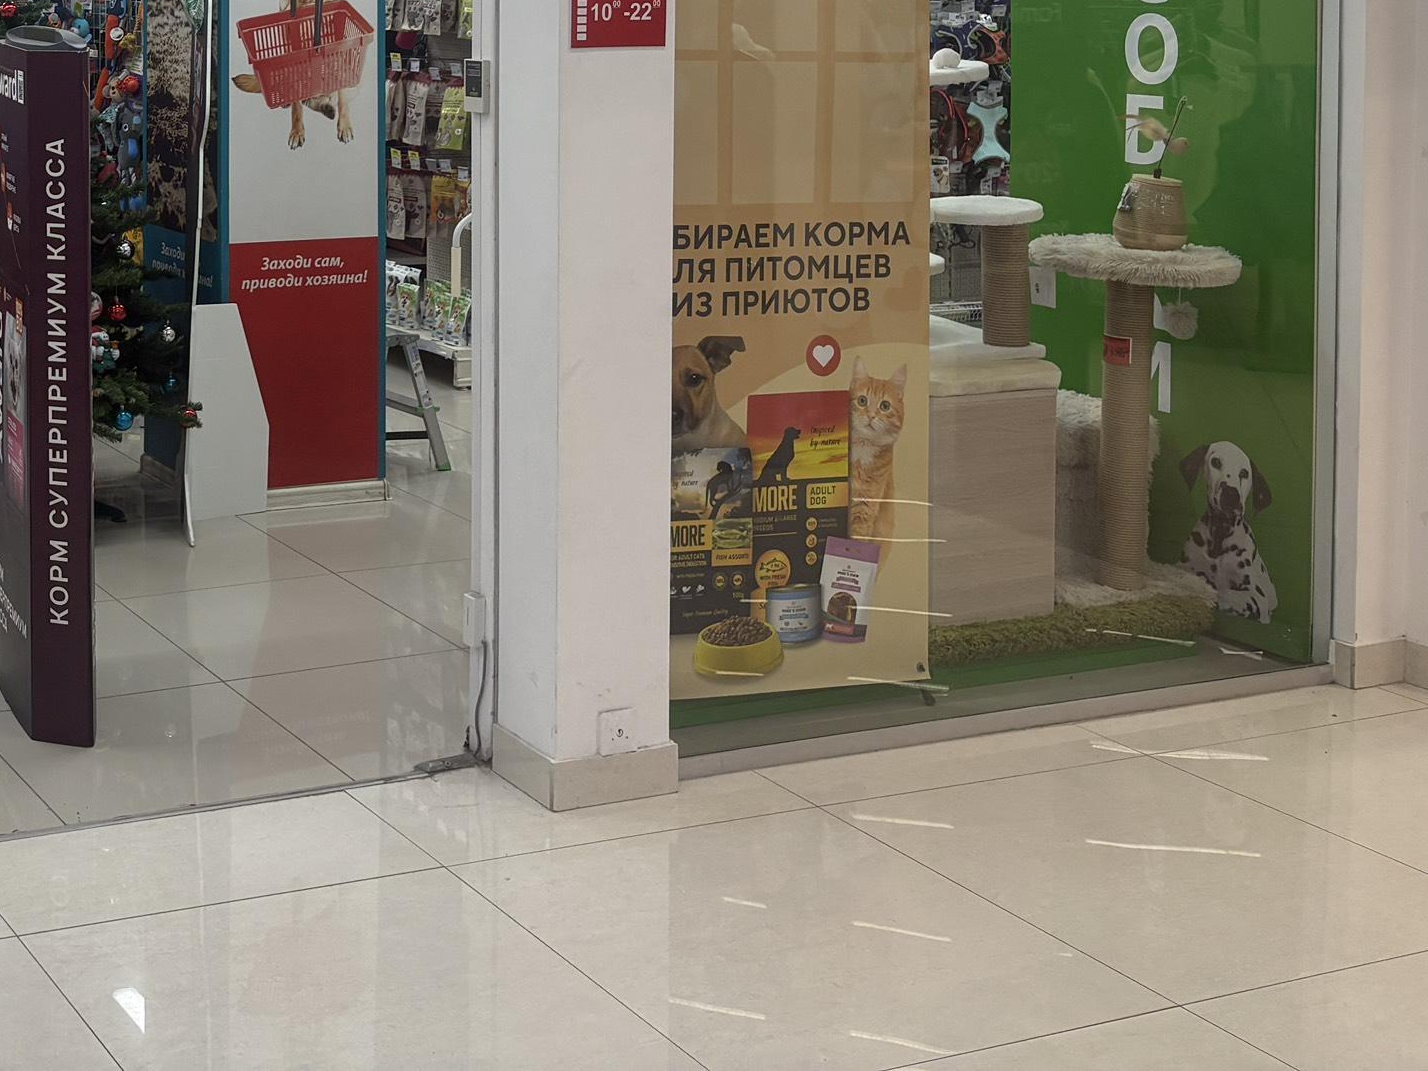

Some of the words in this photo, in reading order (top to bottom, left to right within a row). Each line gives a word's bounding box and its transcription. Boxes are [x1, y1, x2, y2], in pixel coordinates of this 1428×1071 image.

[45, 138, 66, 261] КЛАССА
[673, 223, 794, 250] БИРАЕМ
[804, 221, 911, 247] КОРМА
[161, 242, 186, 261] Заходи
[261, 255, 312, 271] Заходи
[315, 257, 345, 269] сам,
[241, 274, 303, 292] приводи
[305, 270, 369, 287] хозяина!
[673, 258, 716, 283] ЛЯ
[725, 254, 892, 283] ПИТОМЦЕВ
[673, 292, 713, 317] ИЗ
[722, 287, 870, 316] ПРИЮТОВ
[46, 273, 69, 529] СУПЕРПРЕМИУМ
[752, 485, 798, 513] MORE
[810, 485, 836, 495] ADULT
[810, 496, 827, 505] DOG
[671, 524, 706, 548] MORE
[49, 539, 69, 626] КОРМ
